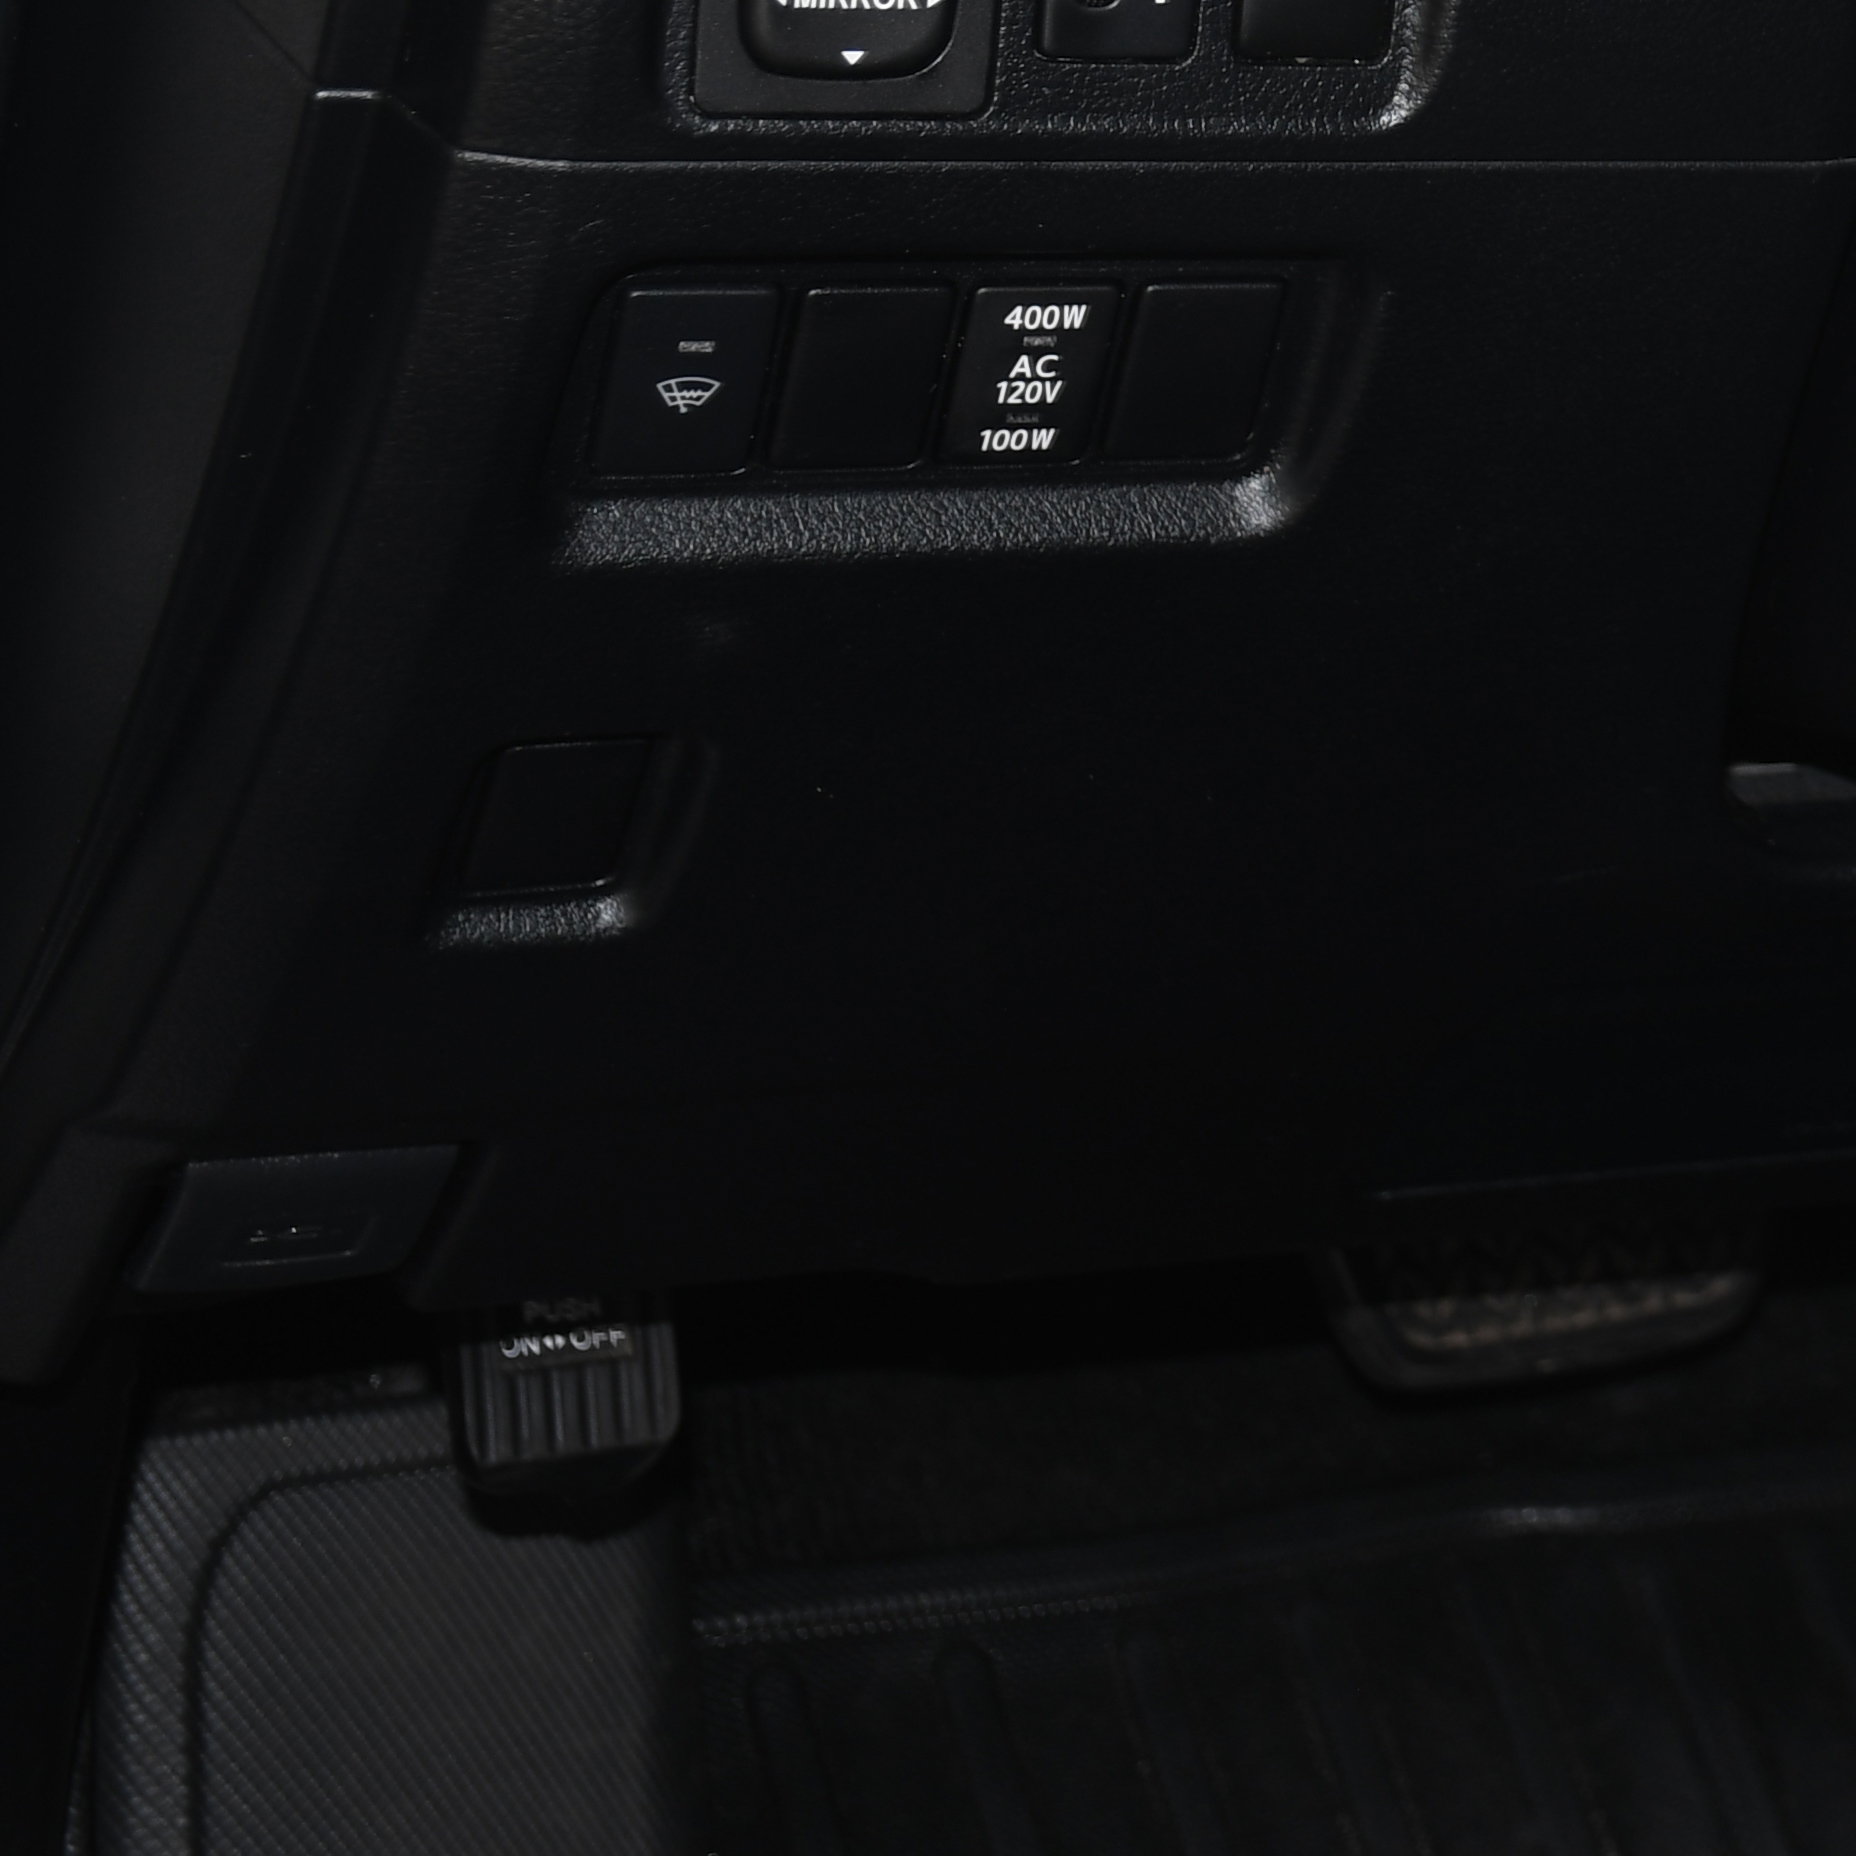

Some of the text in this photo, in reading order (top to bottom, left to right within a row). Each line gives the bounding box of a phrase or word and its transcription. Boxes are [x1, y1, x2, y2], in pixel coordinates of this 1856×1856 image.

[1003, 304, 1088, 331] 400W
[1008, 354, 1061, 379] AC
[996, 379, 1064, 405] 120V
[979, 427, 1057, 453] 100W
